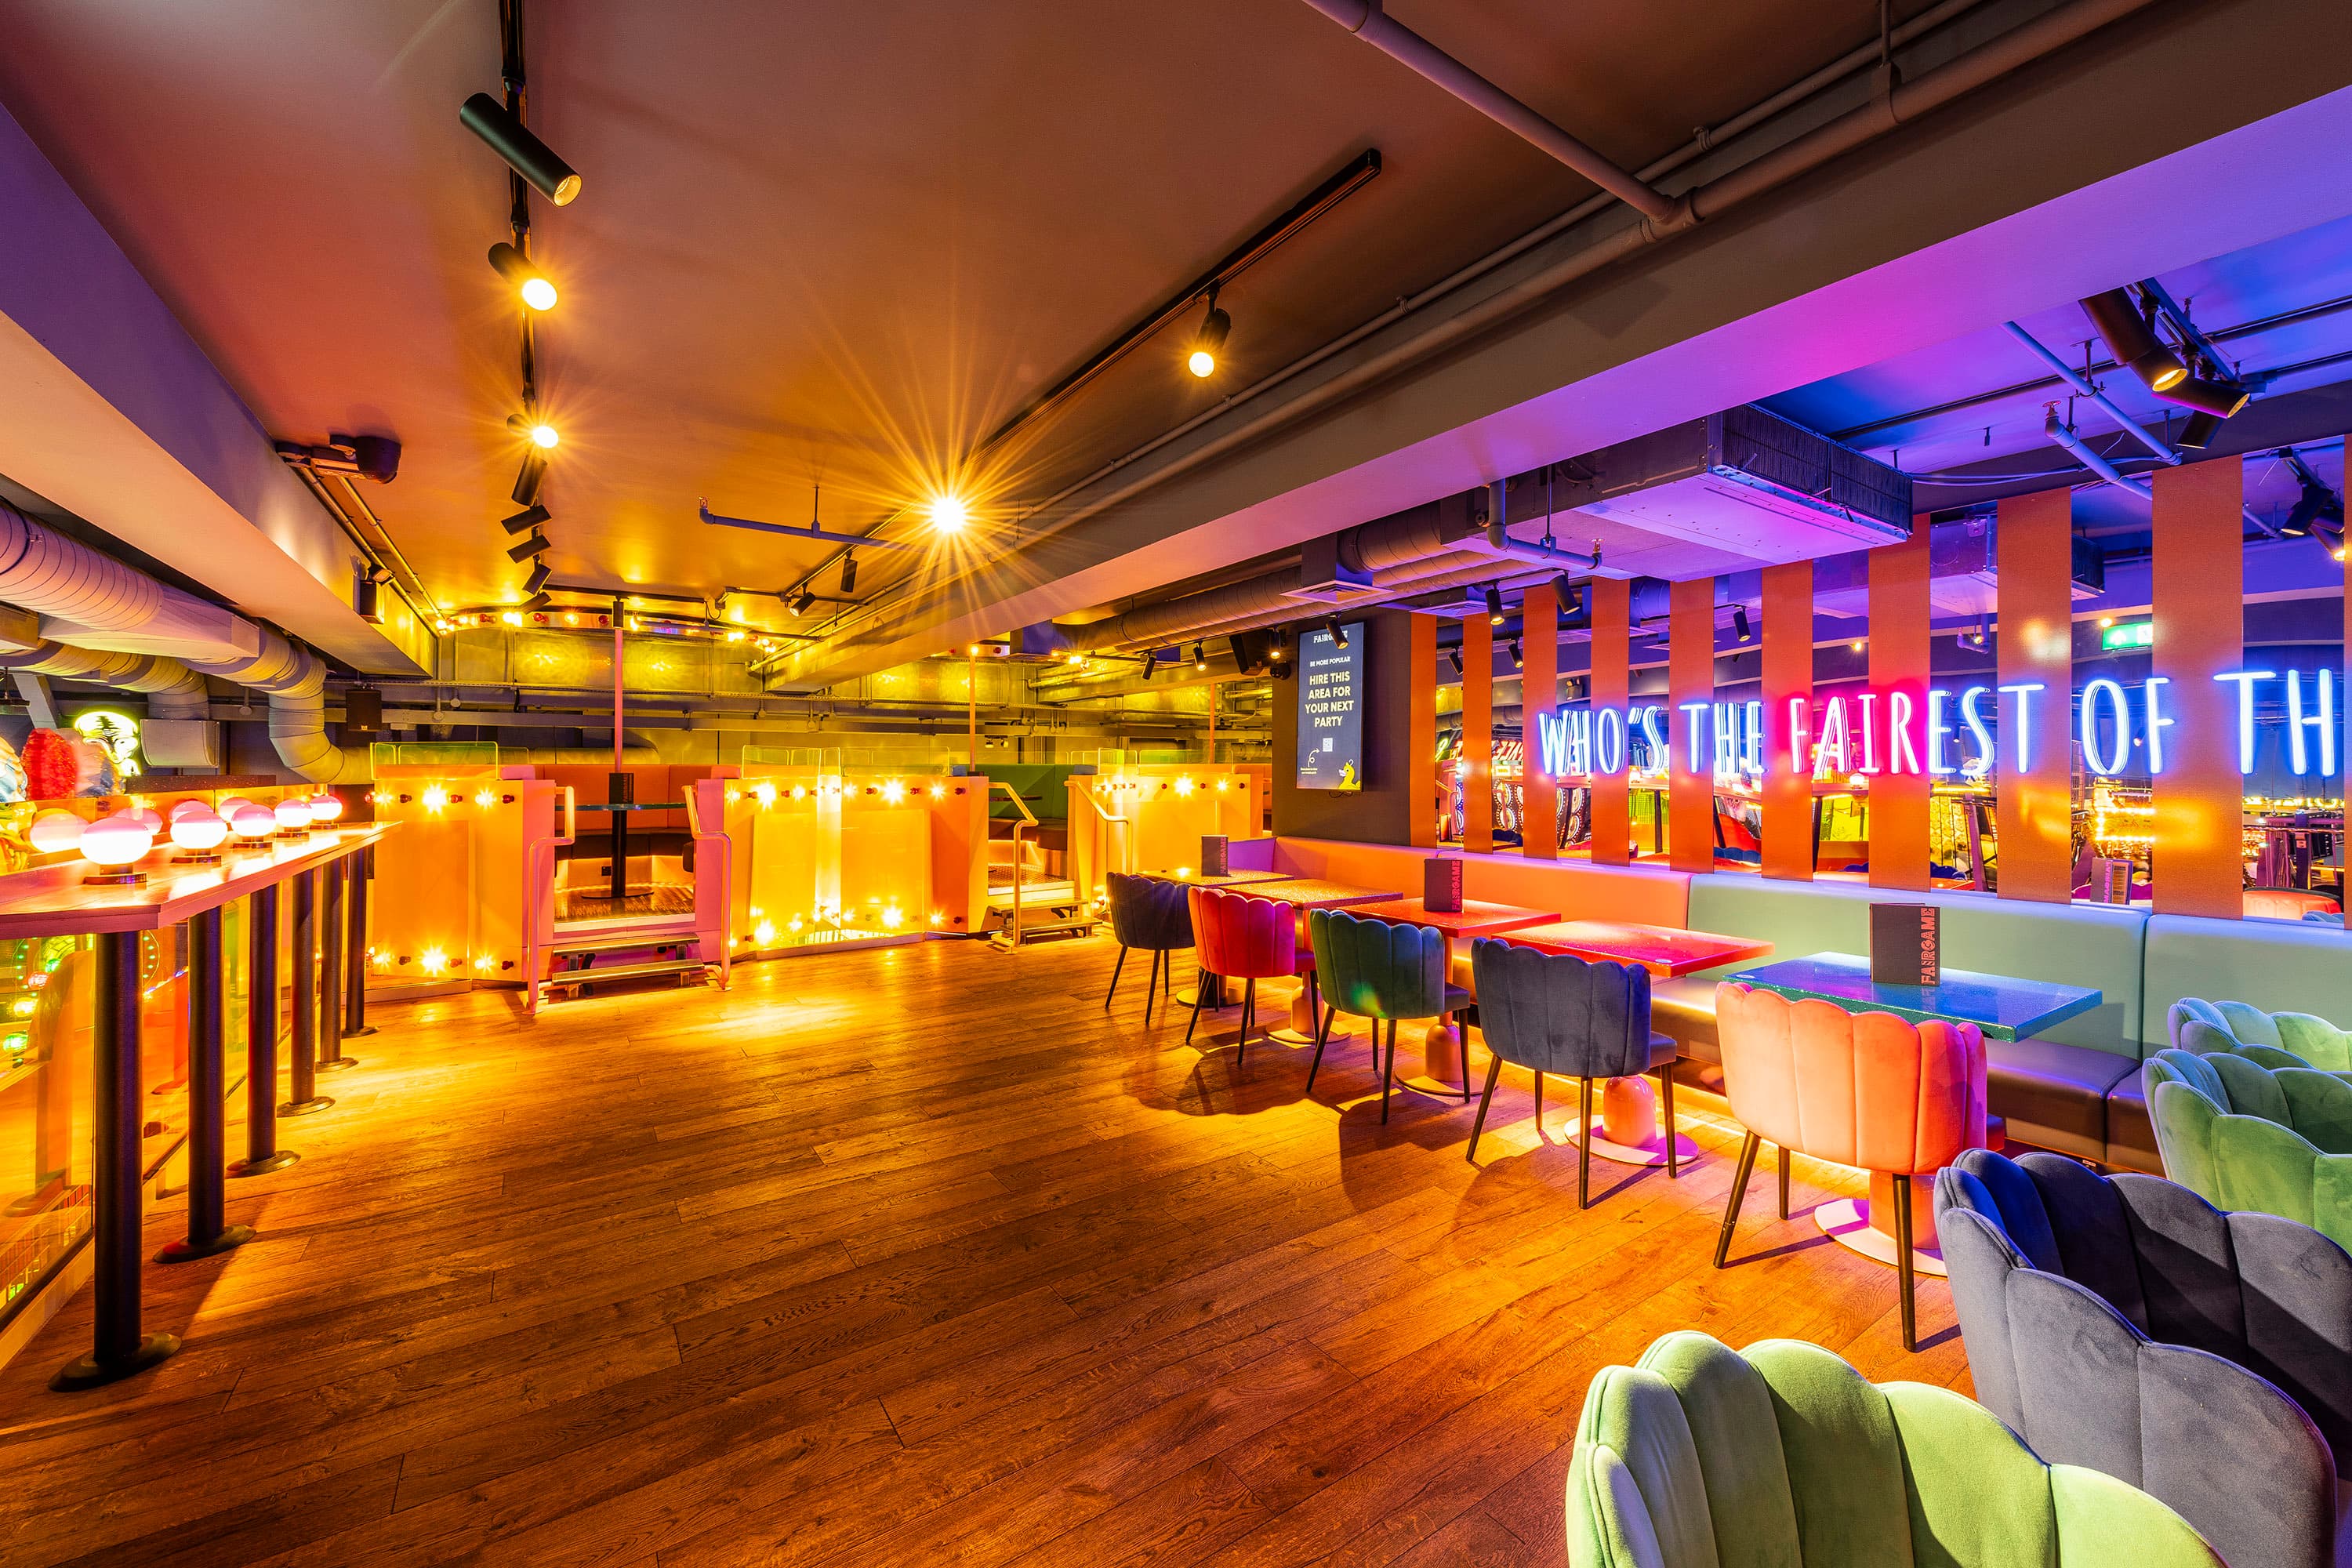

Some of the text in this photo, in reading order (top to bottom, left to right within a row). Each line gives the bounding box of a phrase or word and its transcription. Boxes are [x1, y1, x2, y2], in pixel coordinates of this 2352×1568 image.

[1314, 630, 1348, 643] FAIRGE
[1329, 656, 1351, 665] POPULAR
[1310, 671, 1350, 685] HIRE THIS
[1308, 685, 1351, 700] AREA FOR
[1305, 700, 1355, 714] YOUR NEXT
[1314, 716, 1343, 728] PARTY
[1539, 705, 1664, 775] WHO'S
[1679, 701, 1765, 775] THE
[1790, 684, 2045, 775] FAIREST
[2082, 678, 2175, 775] OF
[1452, 860, 1461, 910] FAIRGAME
[1921, 907, 1935, 985] FAIRGAME
